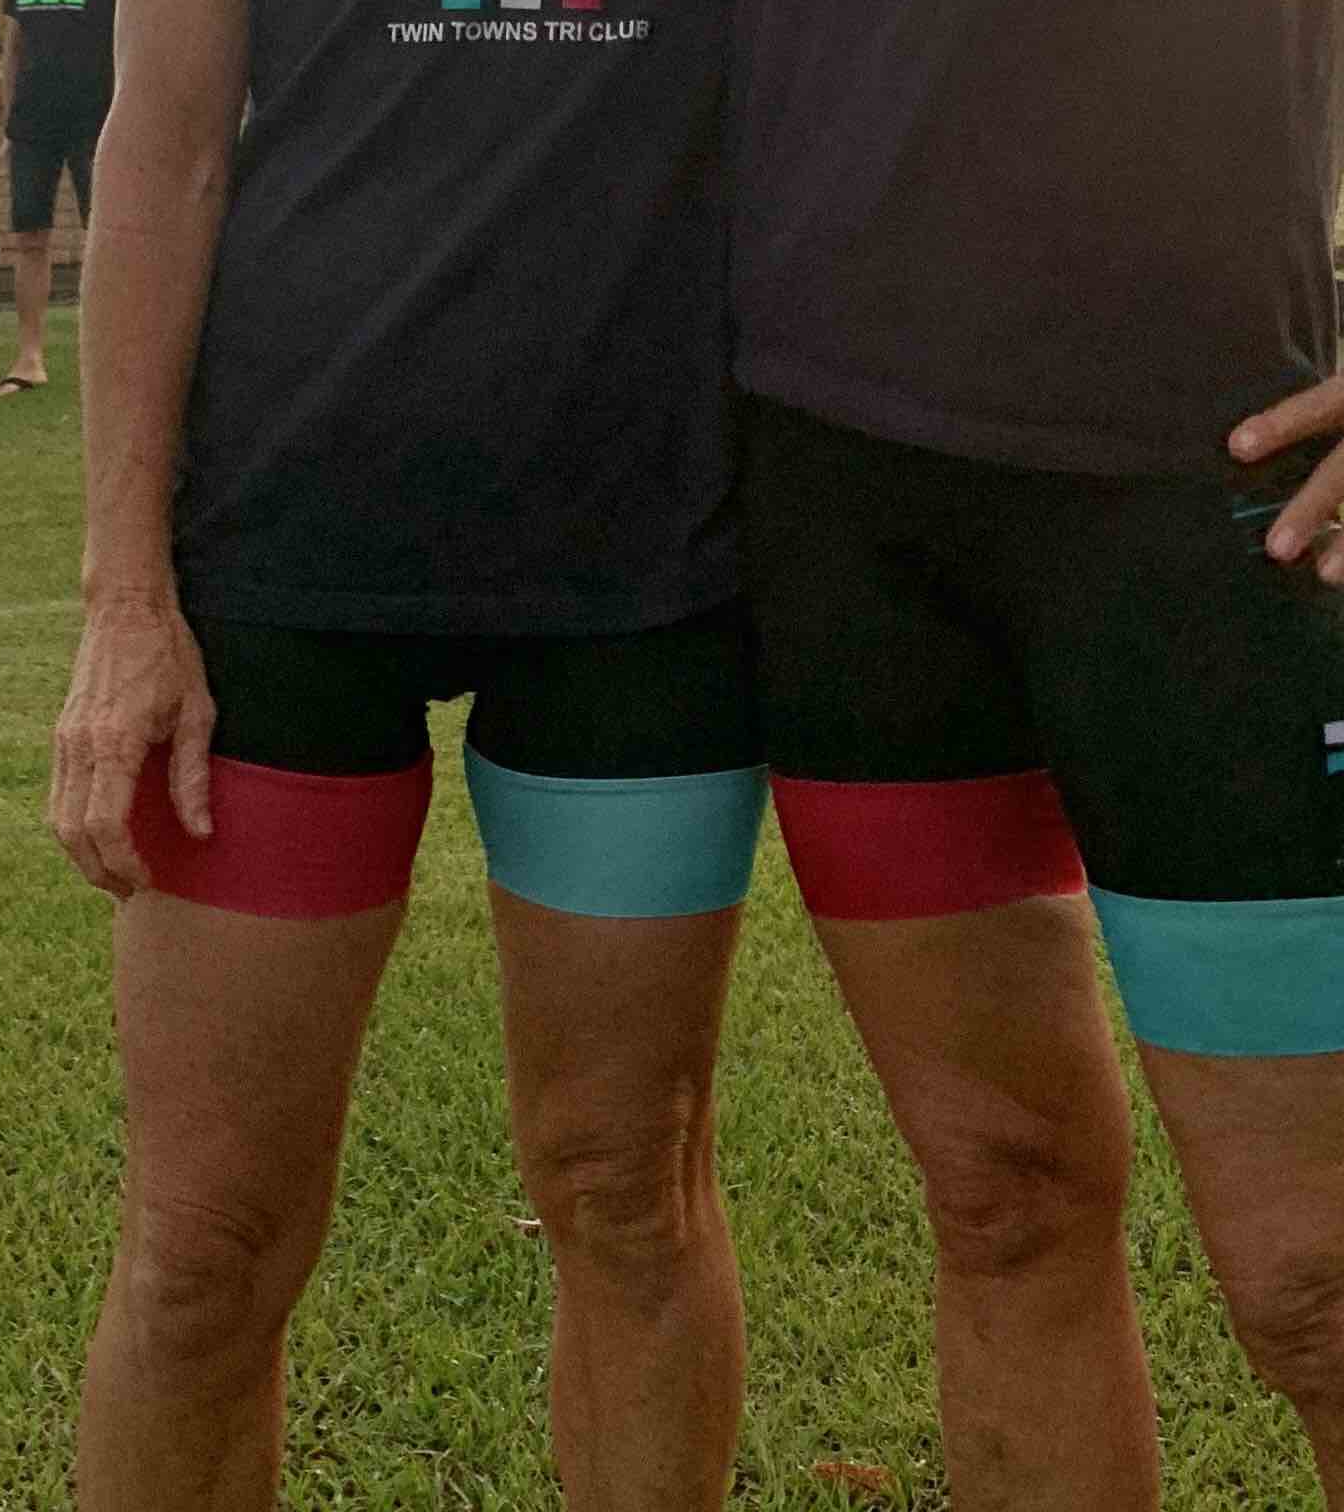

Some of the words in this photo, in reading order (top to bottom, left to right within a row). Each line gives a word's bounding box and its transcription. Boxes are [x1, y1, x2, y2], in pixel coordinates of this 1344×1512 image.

[388, 22, 444, 43] TWIN
[451, 21, 537, 41] TOWNS
[544, 21, 582, 41] TRI
[589, 19, 649, 41] CLUB
